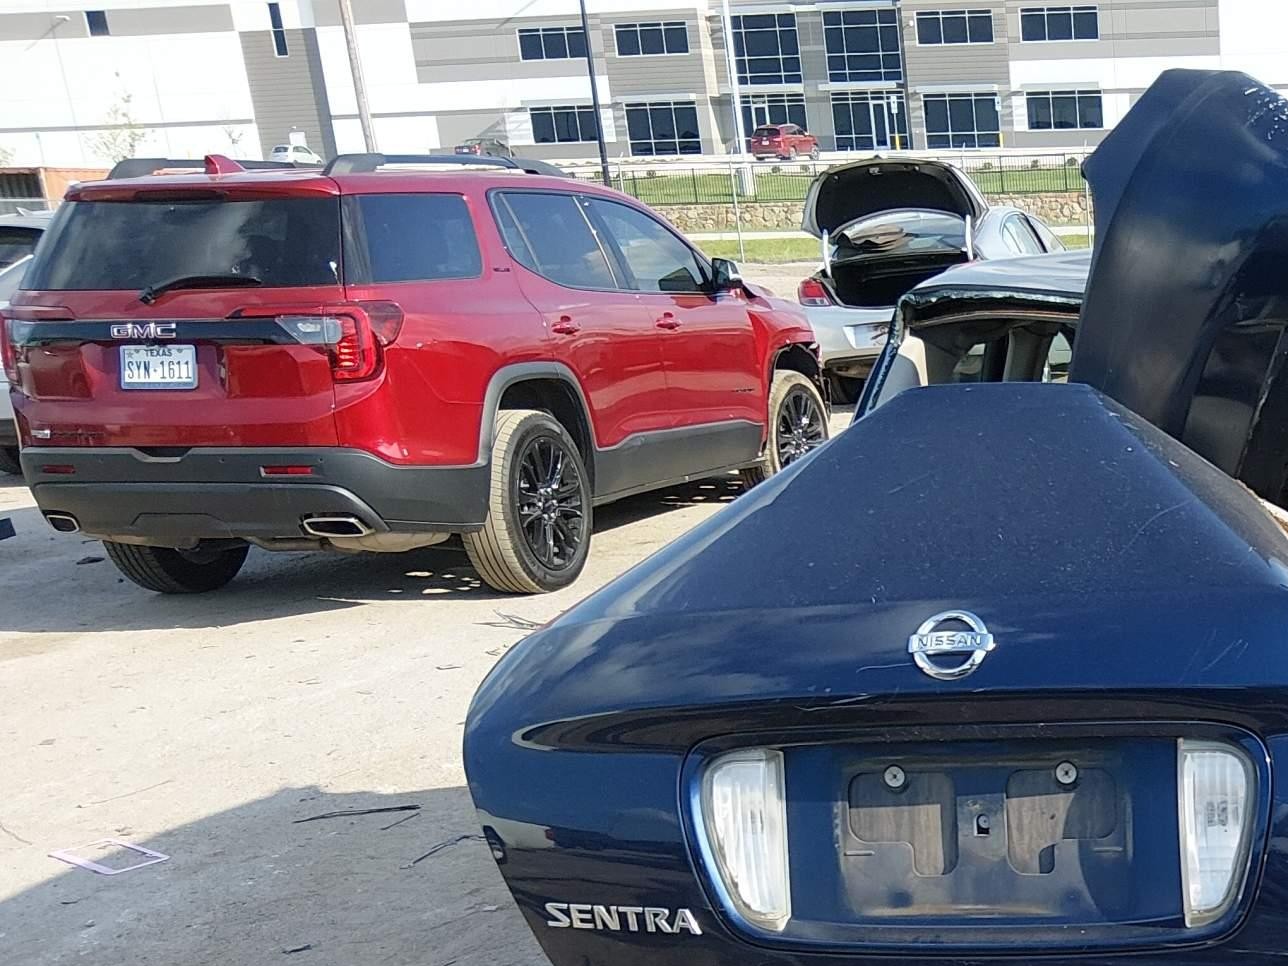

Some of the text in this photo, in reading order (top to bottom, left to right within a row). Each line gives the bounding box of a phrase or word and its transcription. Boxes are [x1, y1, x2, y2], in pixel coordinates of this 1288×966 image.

[110, 323, 177, 339] GMC
[144, 348, 173, 357] TEXAS
[917, 635, 982, 647] NISSAN
[544, 902, 703, 935] SENTRA
